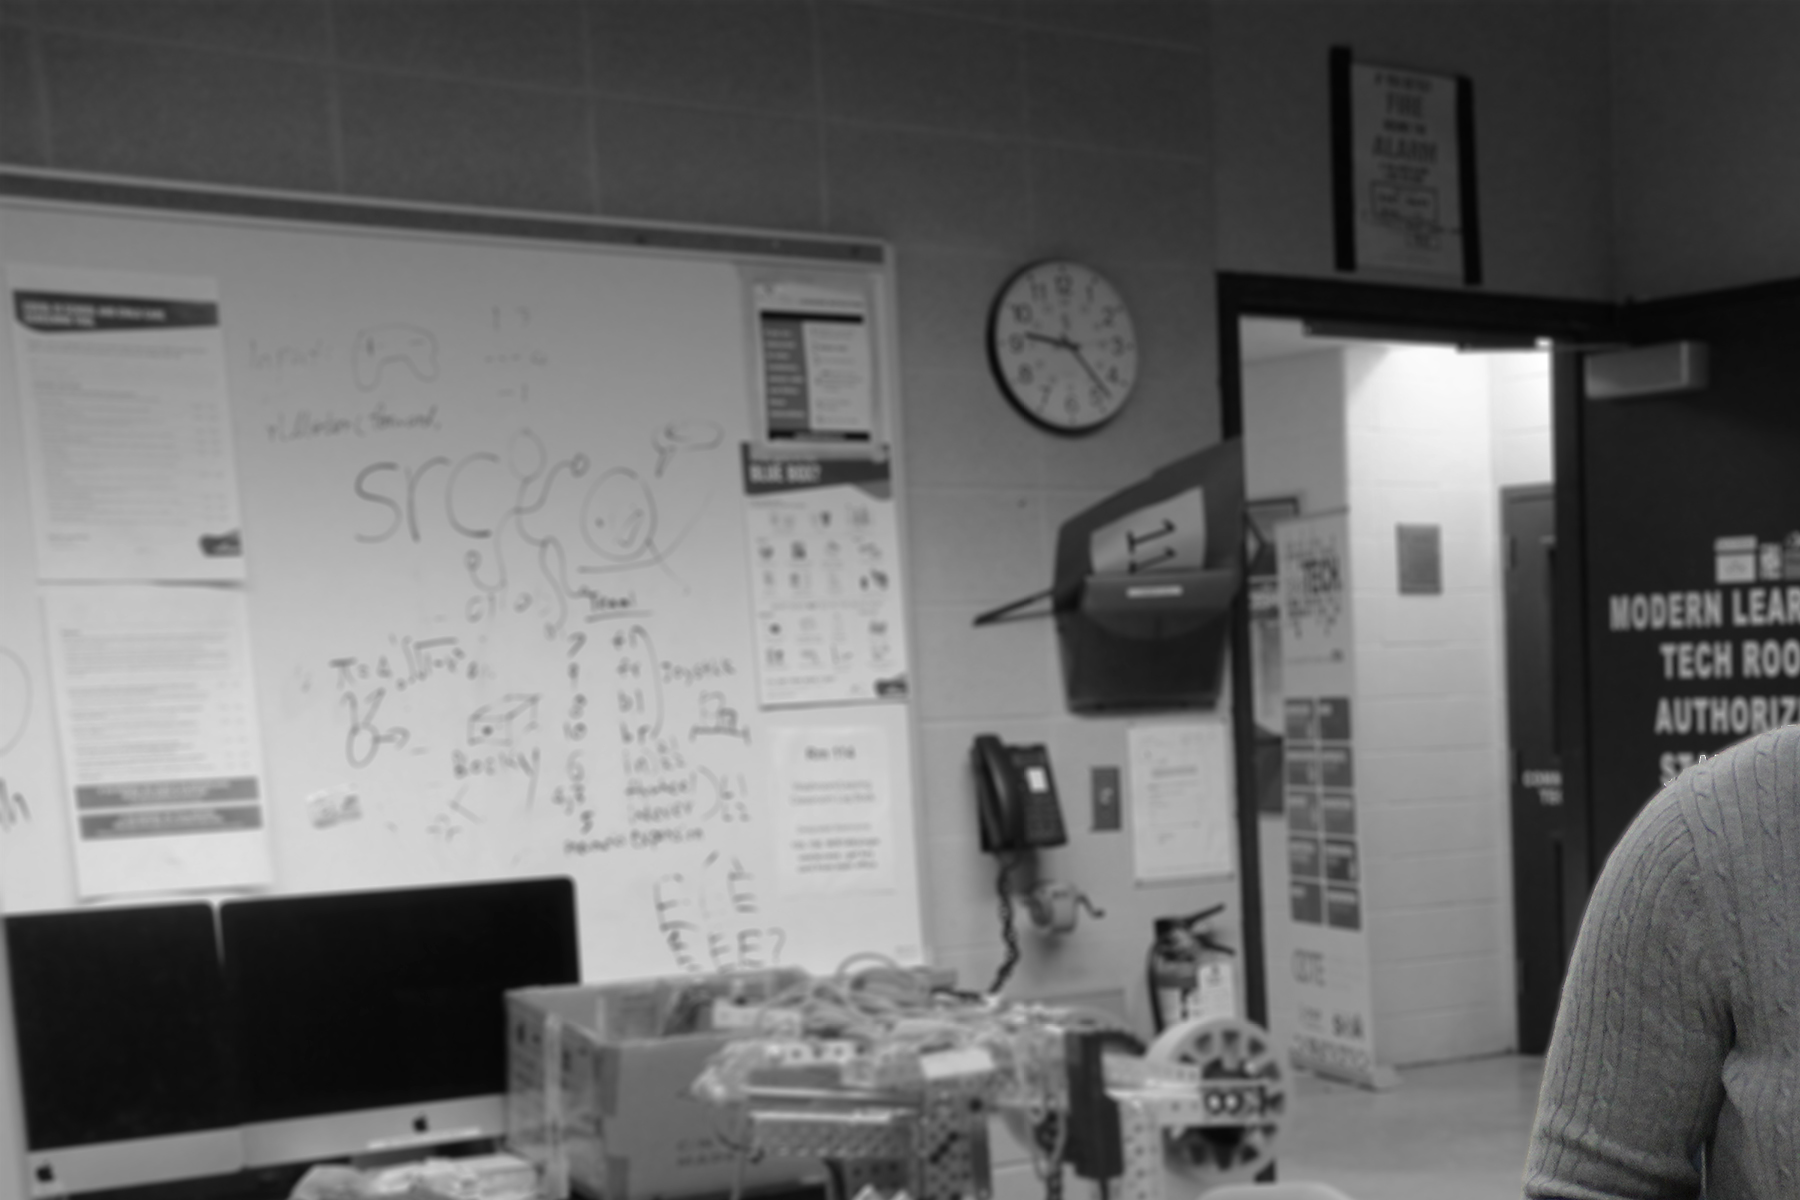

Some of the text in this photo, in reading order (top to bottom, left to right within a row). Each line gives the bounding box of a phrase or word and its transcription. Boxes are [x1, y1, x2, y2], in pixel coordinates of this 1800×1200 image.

[1012, 302, 1033, 325] 10
[1609, 590, 1723, 632] MODERN
[1658, 640, 1733, 680] TECH
